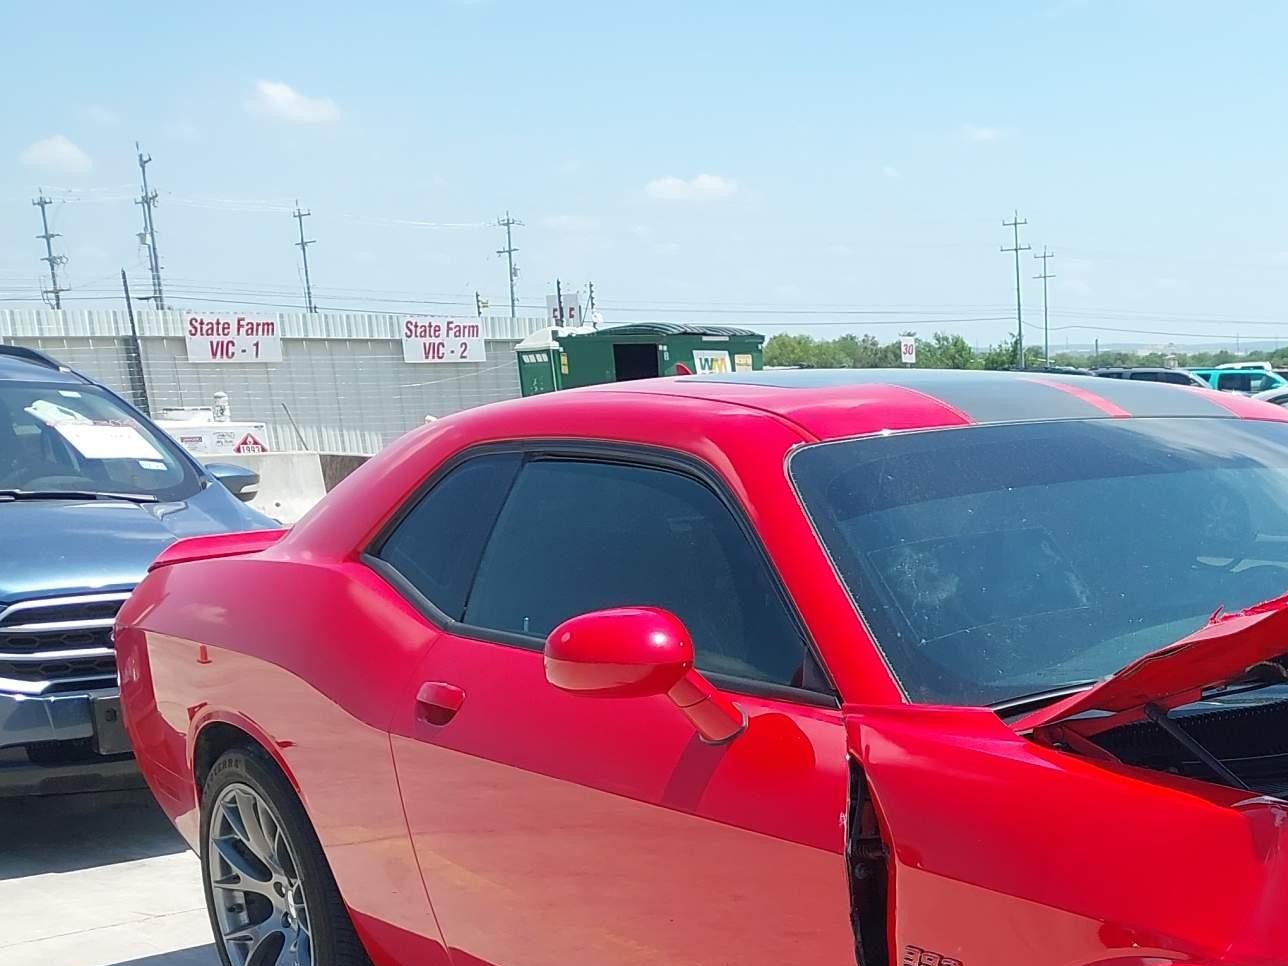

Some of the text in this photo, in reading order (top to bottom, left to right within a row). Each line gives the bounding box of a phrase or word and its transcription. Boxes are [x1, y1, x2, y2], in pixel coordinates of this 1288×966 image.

[188, 317, 275, 337] State Farm
[405, 320, 479, 339] State Farm
[210, 340, 235, 359] VIC
[253, 340, 259, 358] 1
[423, 341, 445, 360] VIC
[459, 342, 468, 359] 2
[903, 344, 914, 356] 30
